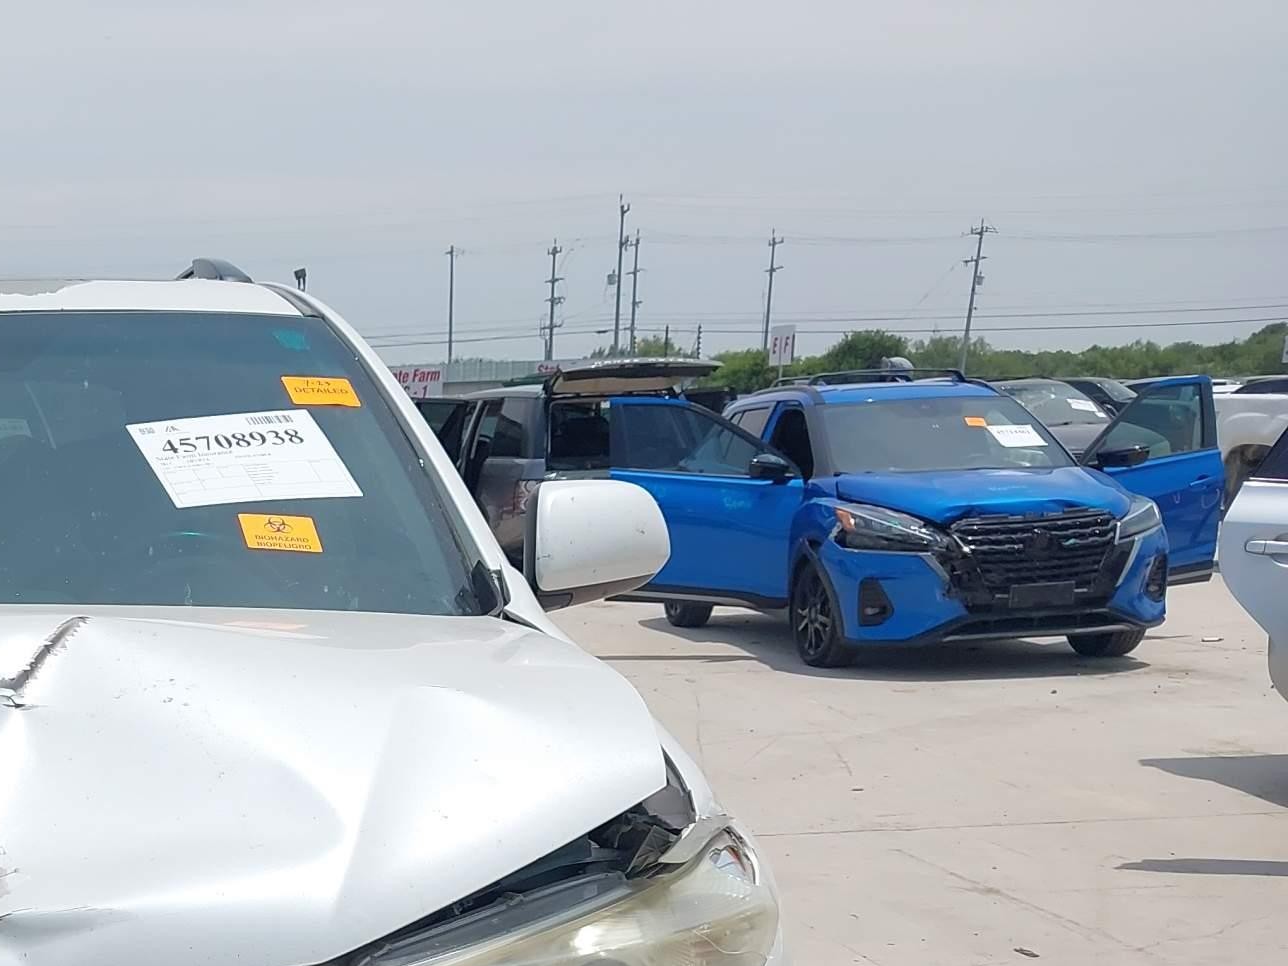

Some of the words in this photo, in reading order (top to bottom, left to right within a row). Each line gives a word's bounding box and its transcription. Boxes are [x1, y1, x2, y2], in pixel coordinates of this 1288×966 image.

[412, 368, 441, 383] Farm
[294, 387, 349, 395] DETAILED
[162, 428, 304, 454] 45708938
[255, 534, 310, 544] BIOHAZARD
